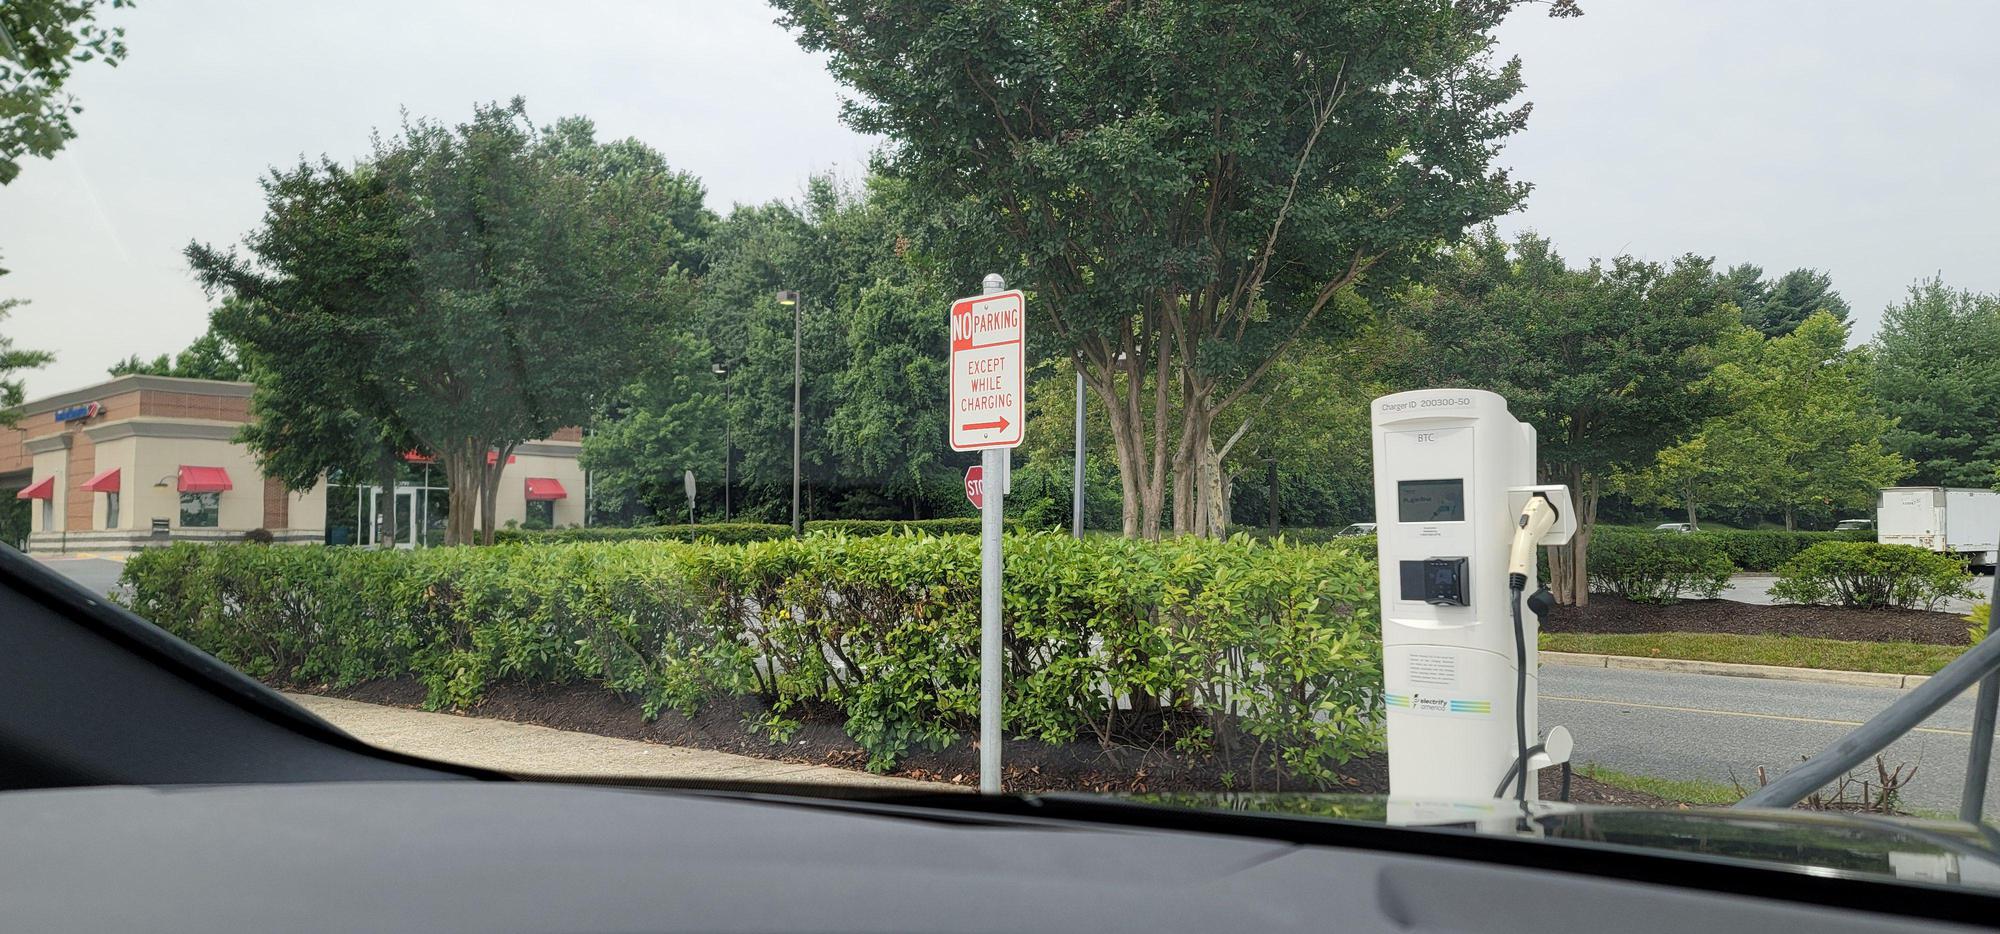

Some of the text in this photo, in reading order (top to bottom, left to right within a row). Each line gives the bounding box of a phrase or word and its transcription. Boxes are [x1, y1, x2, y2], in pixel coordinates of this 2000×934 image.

[953, 309, 1018, 342] NO PARKING
[968, 357, 1005, 375] EXCEPT
[971, 376, 1001, 392] WHILE
[961, 393, 1012, 412] CHARGING
[1382, 398, 1471, 412] Charger ID 200300-50
[1417, 433, 1435, 443] BTC
[967, 479, 984, 497] STO
[1420, 698, 1448, 708] electrify
